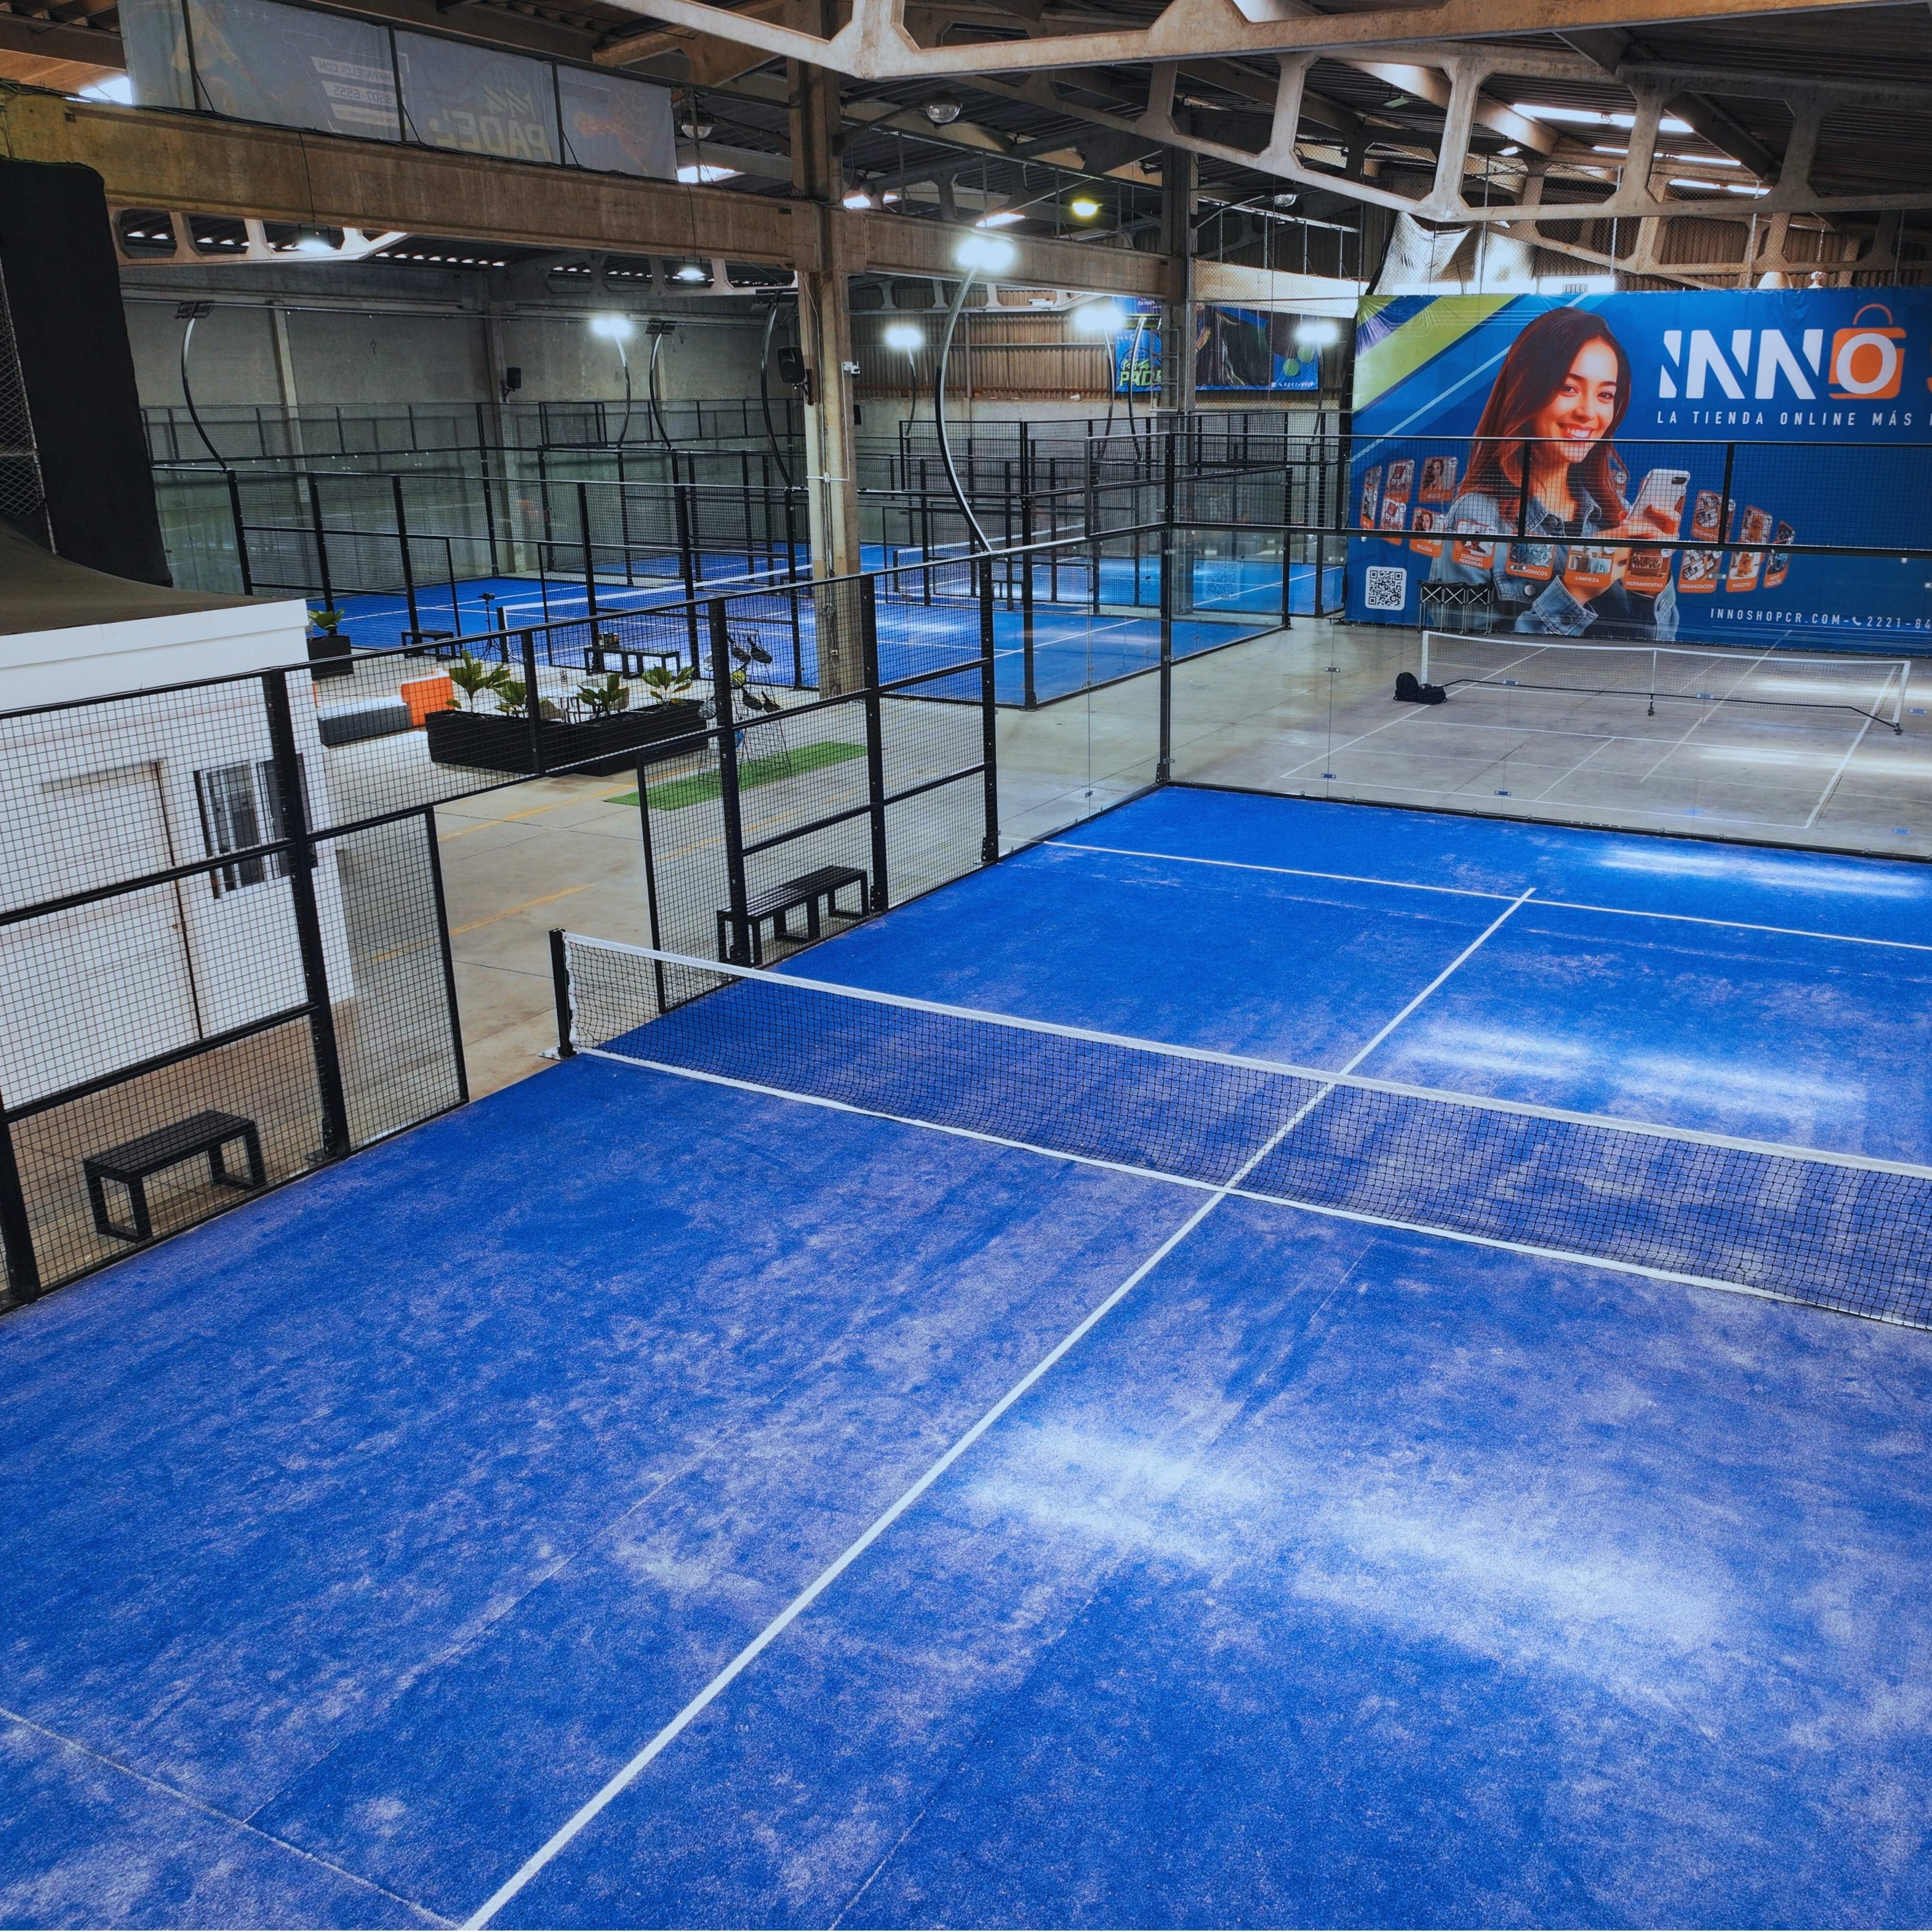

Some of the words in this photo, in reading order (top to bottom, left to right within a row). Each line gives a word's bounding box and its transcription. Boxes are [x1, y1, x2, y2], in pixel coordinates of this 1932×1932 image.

[1659, 329, 1898, 399] INNO
[1658, 411, 1677, 423] LA
[1693, 411, 1764, 425] TIENDA
[1780, 412, 1856, 425] ONLINE
[1872, 410, 1913, 426] MÁS
[1416, 544, 1433, 553] BELLEZA
[1459, 558, 1484, 567] PERSONAL
[1461, 554, 1483, 562] CUIDADO
